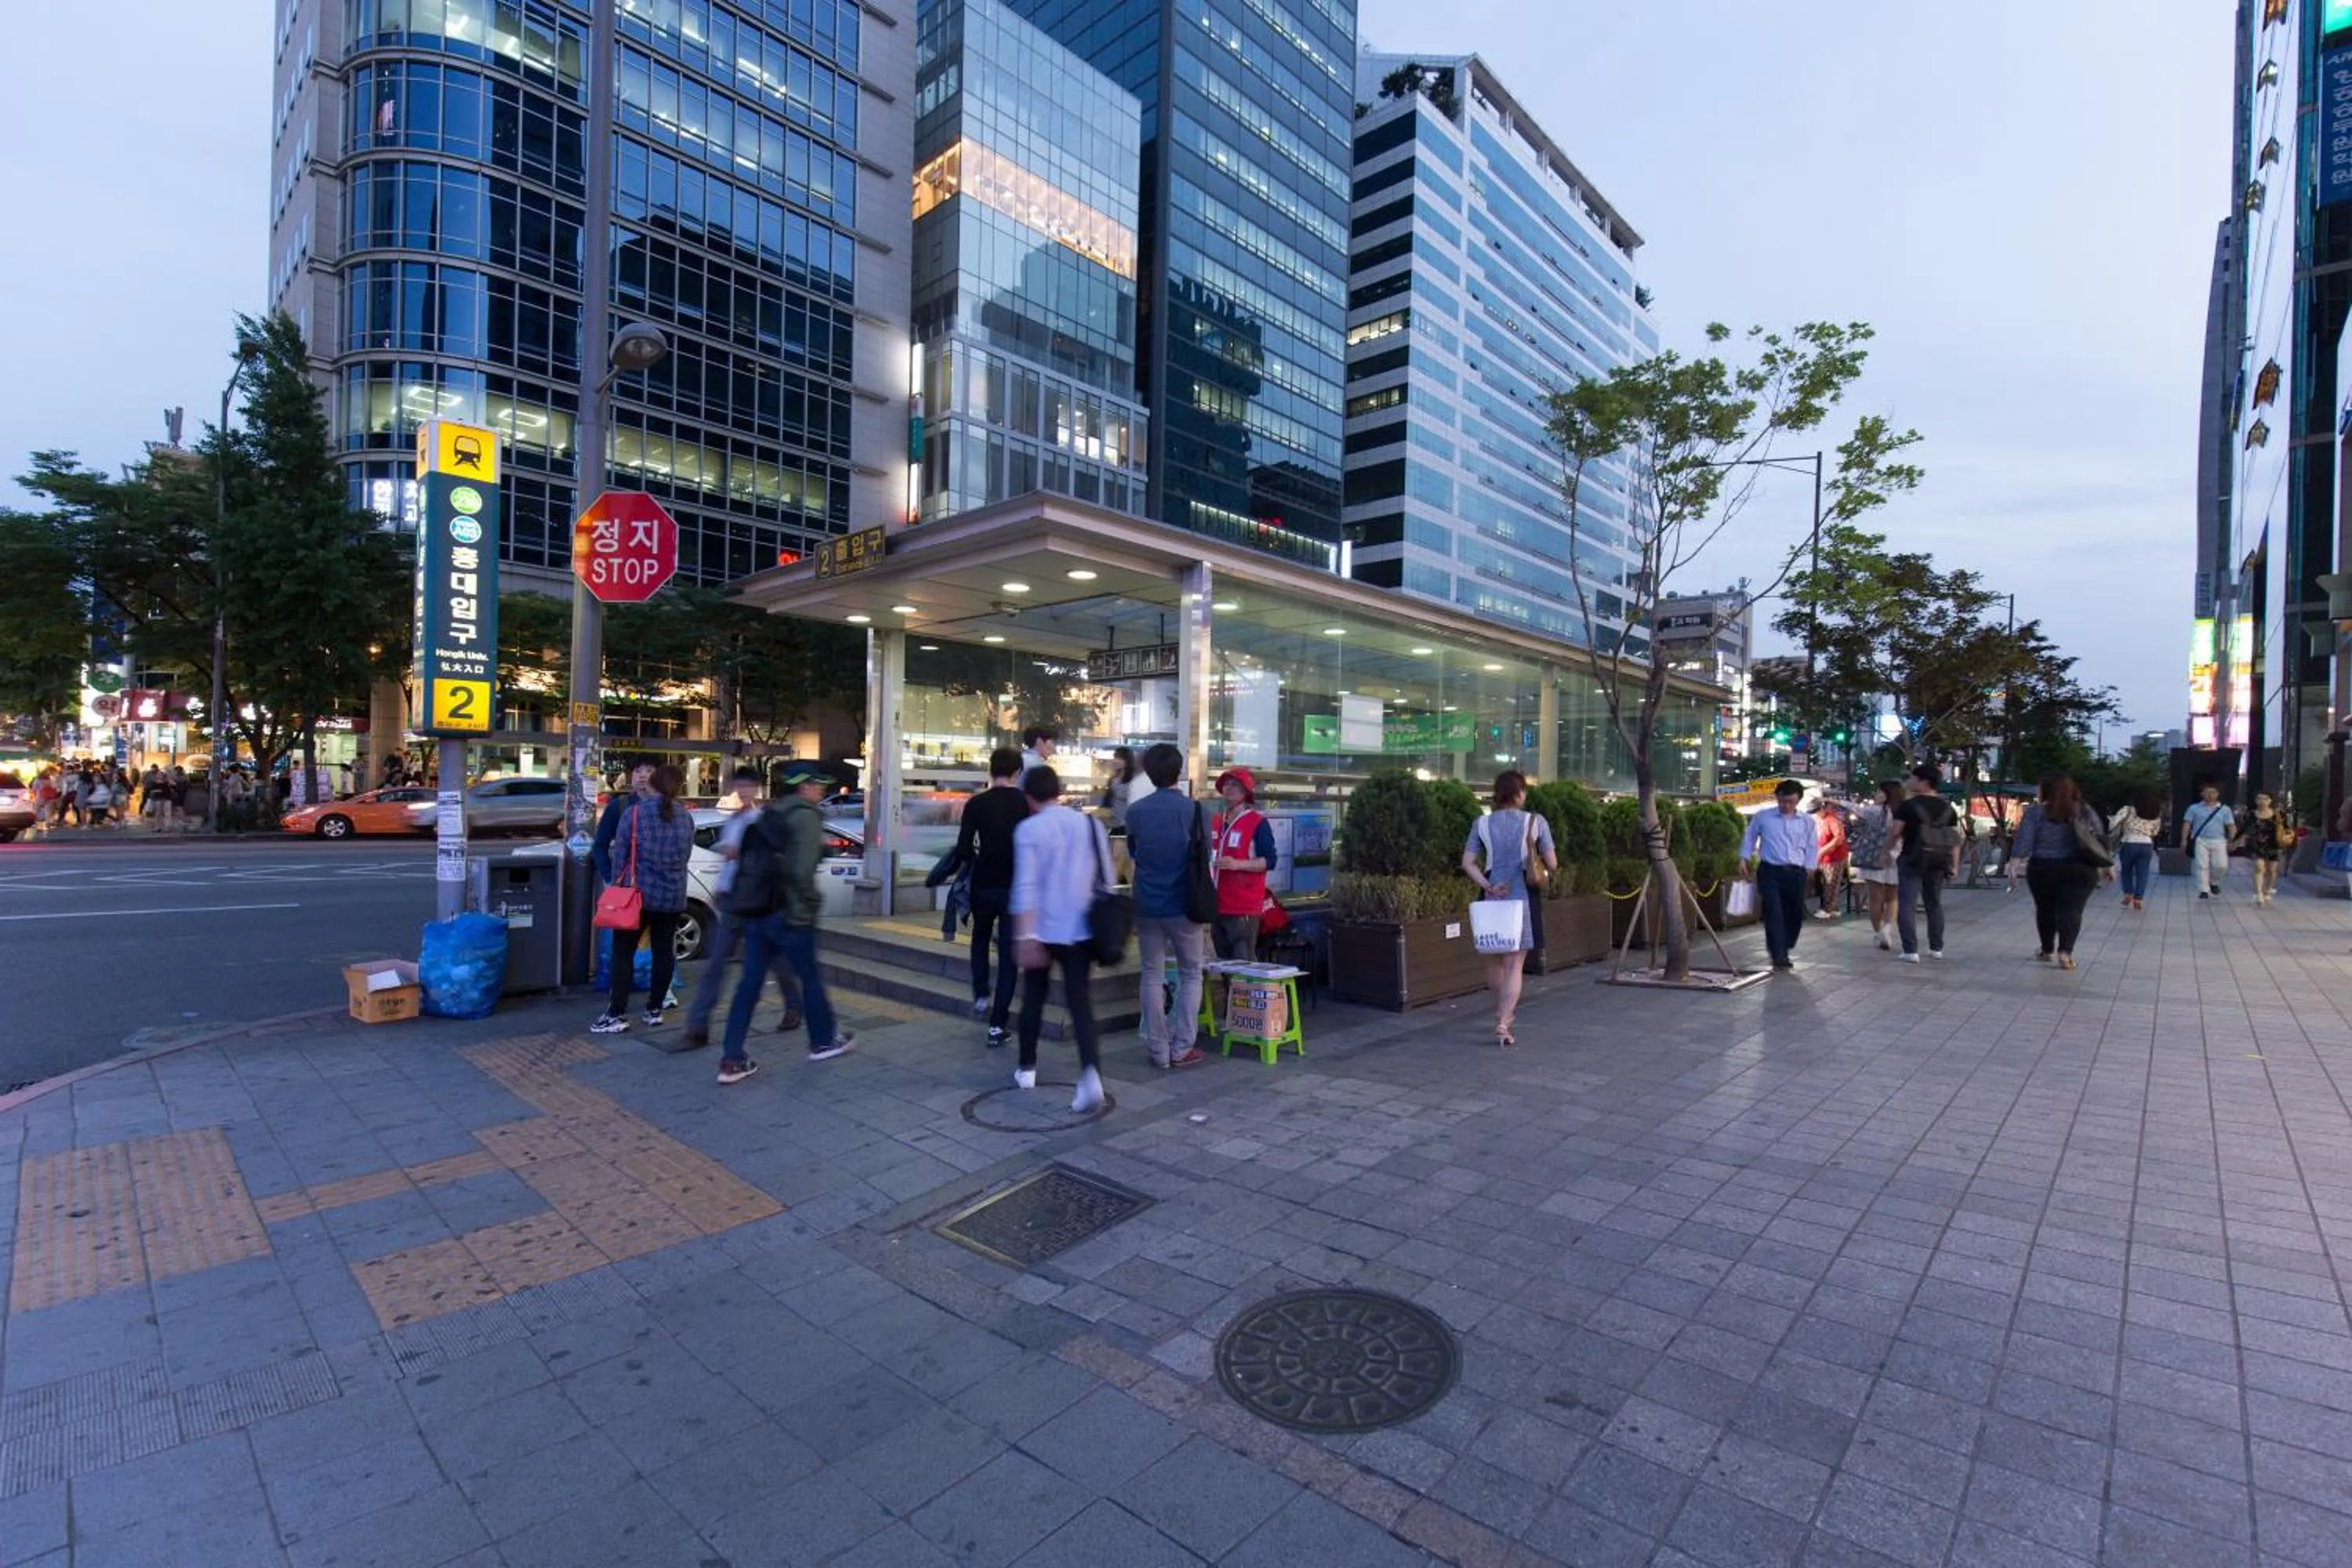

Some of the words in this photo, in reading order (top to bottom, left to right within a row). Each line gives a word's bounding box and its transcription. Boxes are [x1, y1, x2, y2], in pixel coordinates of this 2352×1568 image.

[591, 518, 659, 554] 정지
[591, 557, 659, 584] STOP
[821, 550, 829, 573] 2
[449, 546, 479, 645] 홍대입구
[435, 648, 466, 659] Hongik
[466, 651, 489, 662] Univ.
[441, 662, 484, 673] 弘大入口
[448, 685, 474, 719] 2
